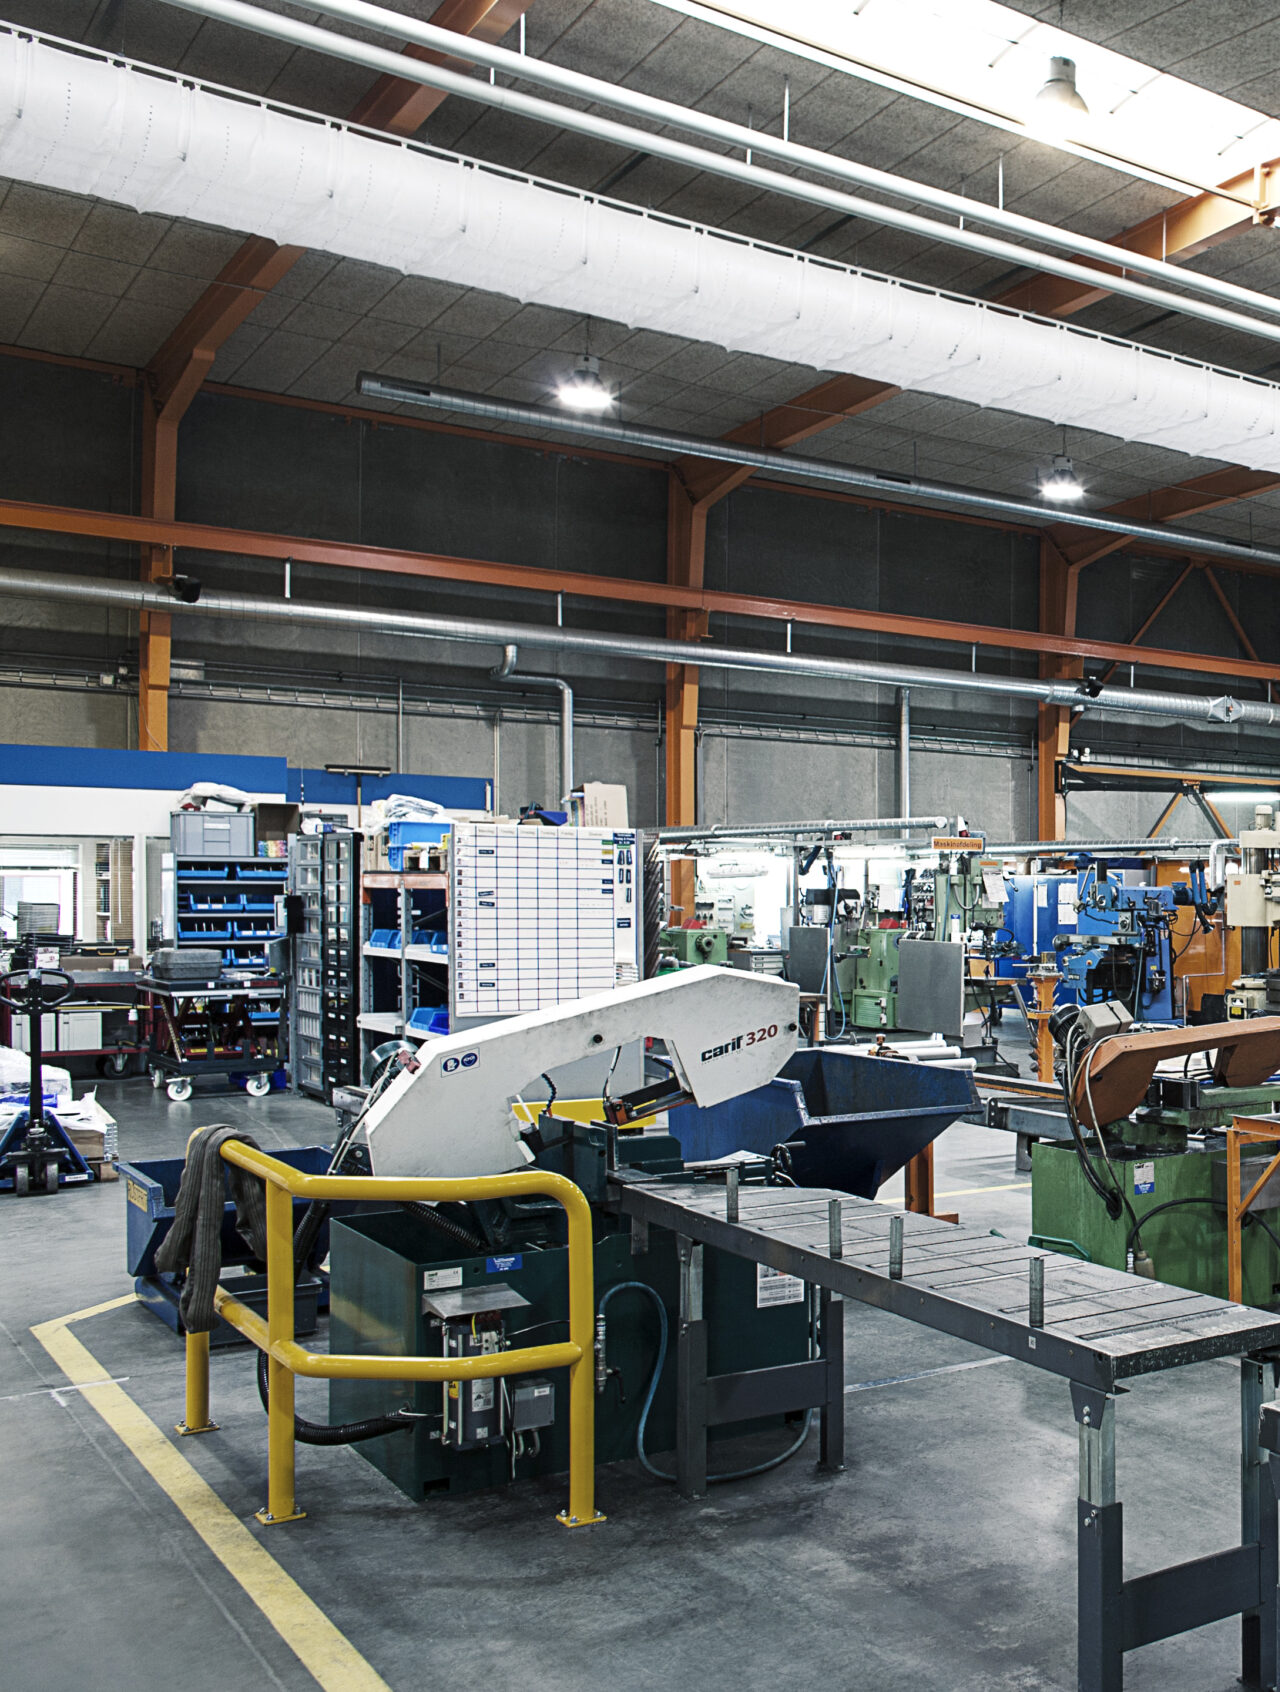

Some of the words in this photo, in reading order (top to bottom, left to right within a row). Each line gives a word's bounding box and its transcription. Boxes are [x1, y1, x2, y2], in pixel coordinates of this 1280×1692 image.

[933, 840, 982, 850] Maskinafdeling
[701, 1035, 744, 1062] carif
[746, 1024, 778, 1046] 320
